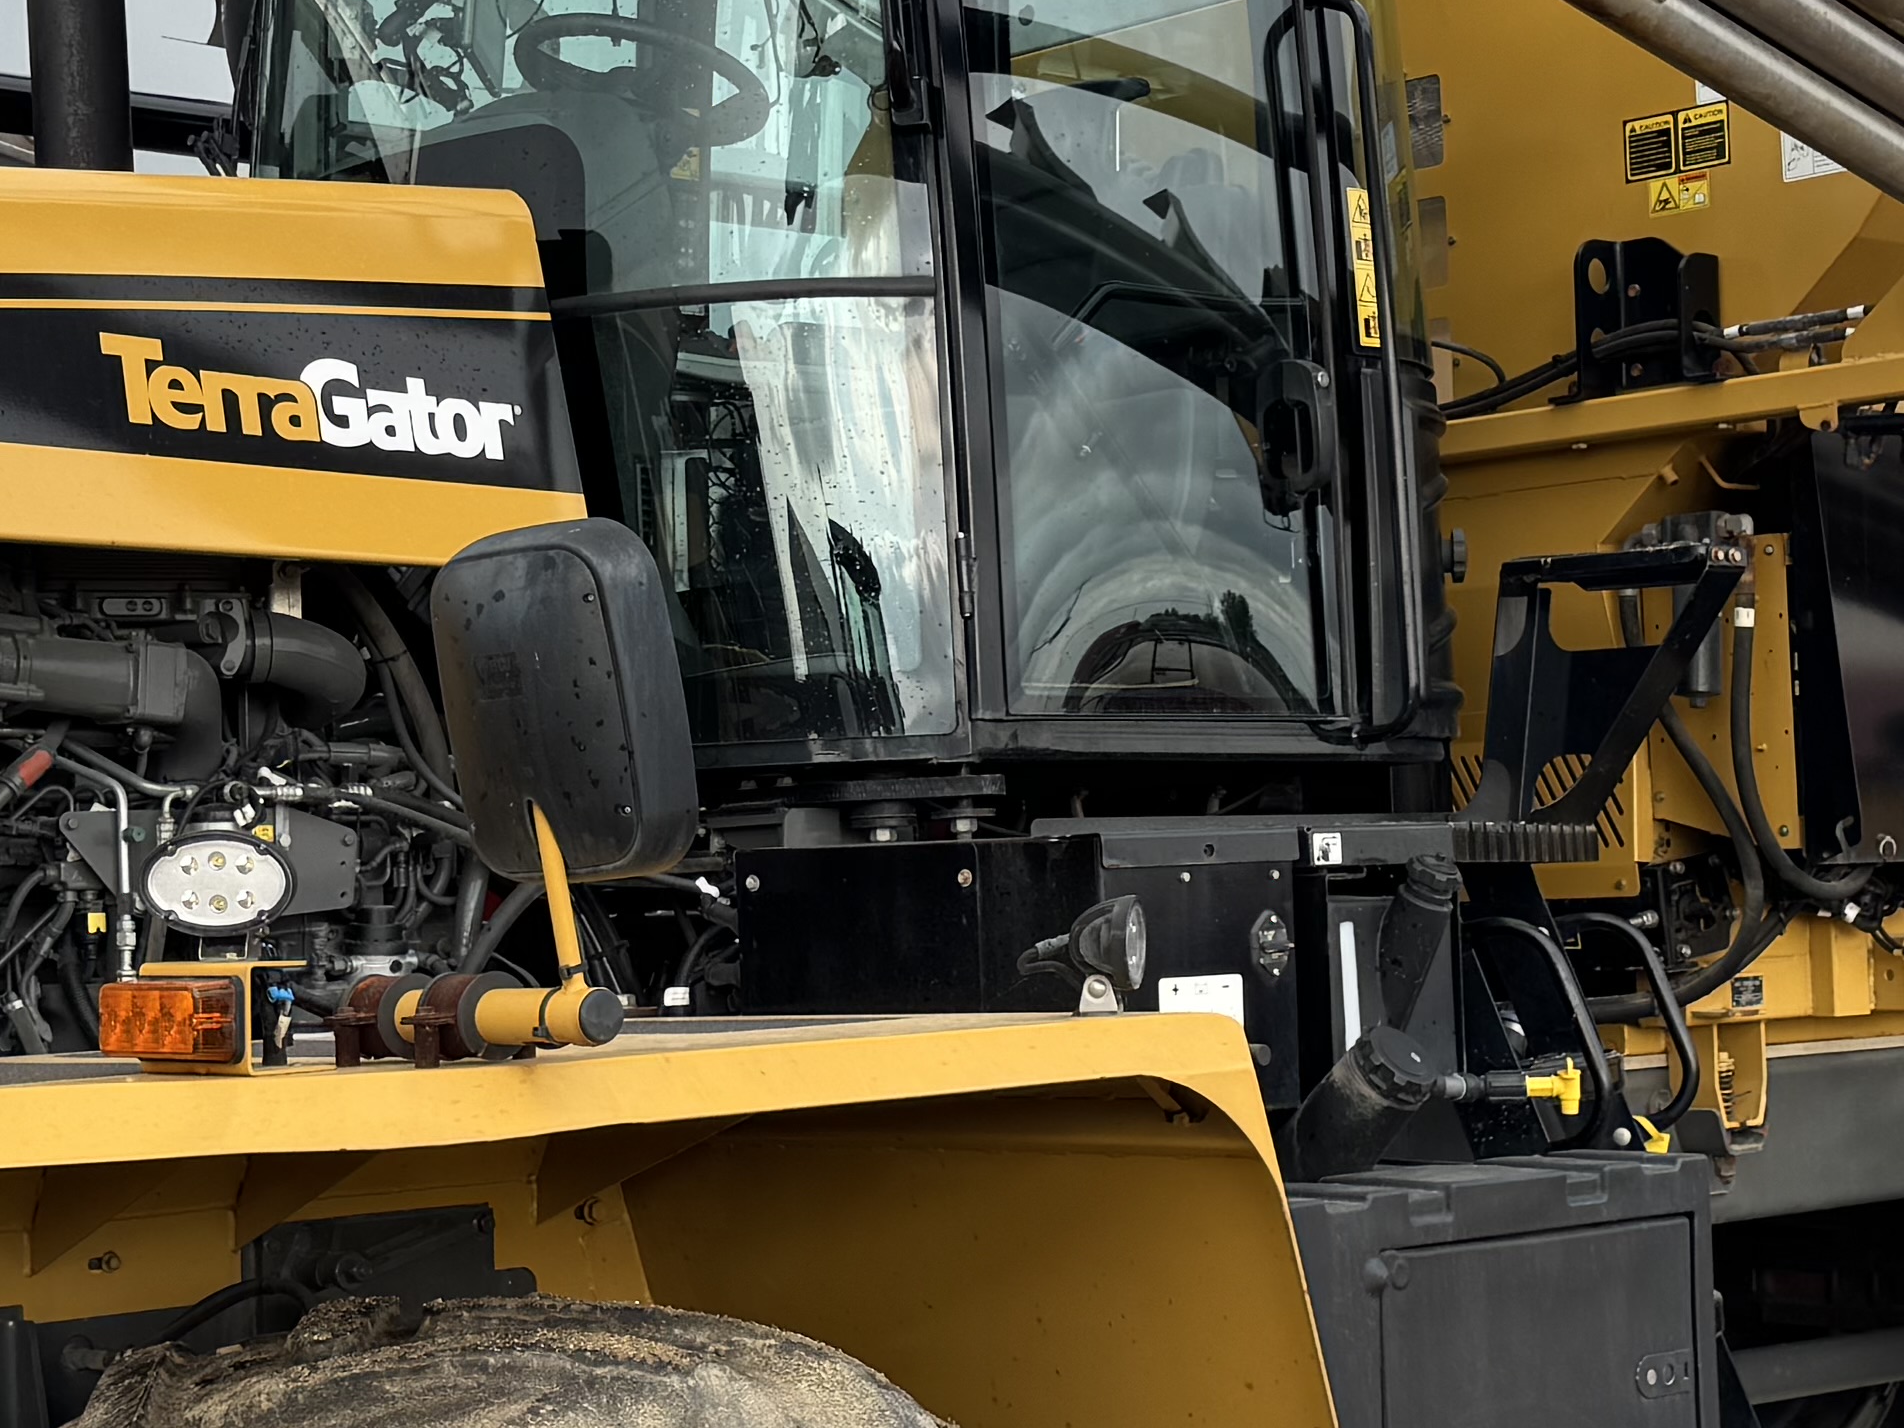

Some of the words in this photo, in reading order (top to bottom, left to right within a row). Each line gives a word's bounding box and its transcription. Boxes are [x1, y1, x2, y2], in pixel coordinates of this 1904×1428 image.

[1693, 108, 1724, 121] CAUTION
[1639, 119, 1671, 132] CAUTION
[99, 332, 516, 461] TerraGator
